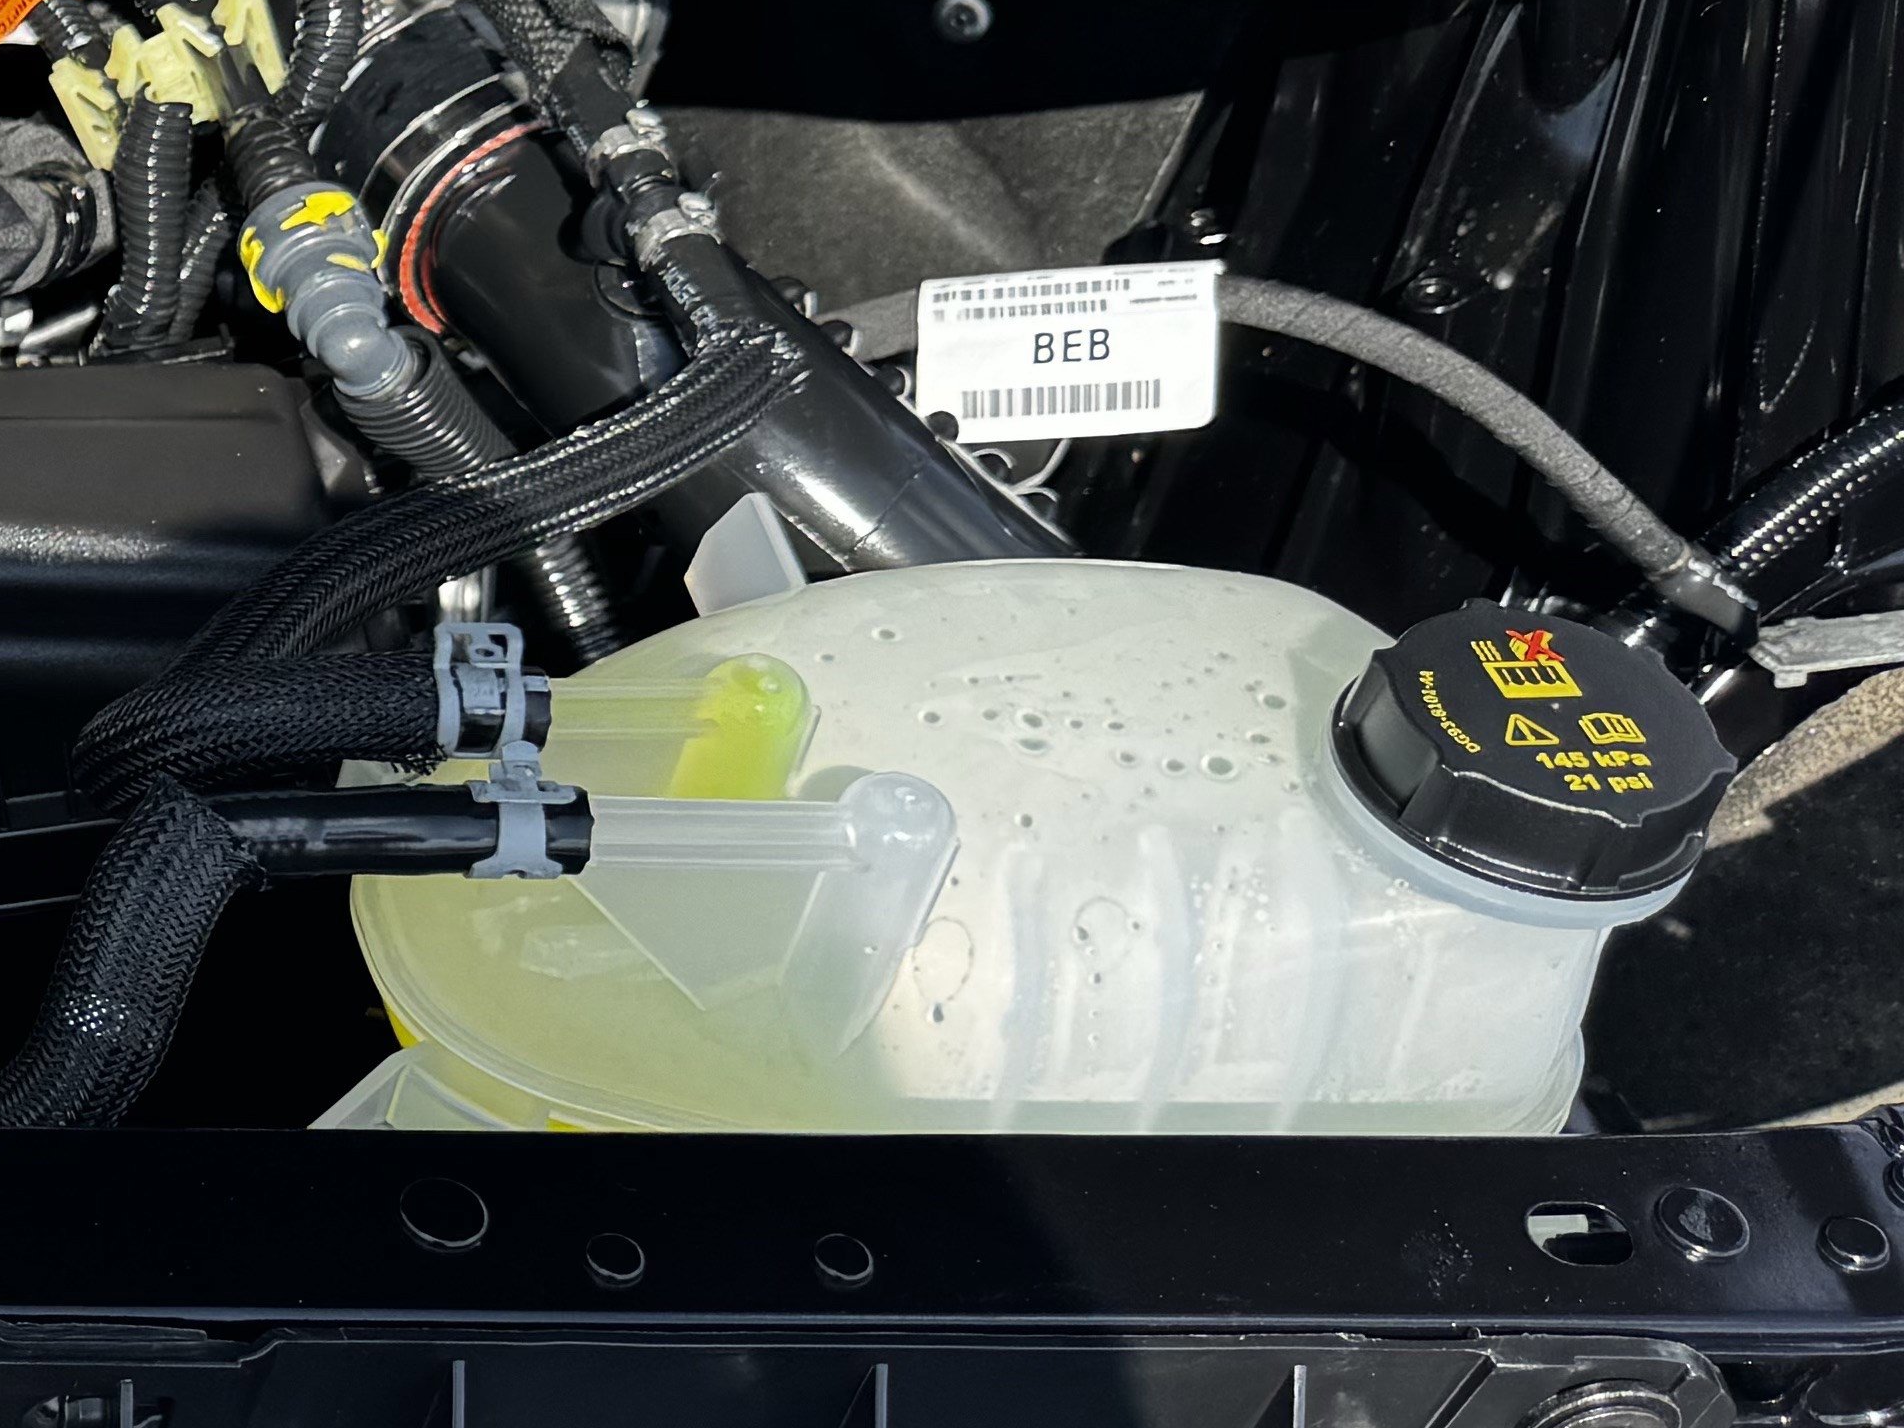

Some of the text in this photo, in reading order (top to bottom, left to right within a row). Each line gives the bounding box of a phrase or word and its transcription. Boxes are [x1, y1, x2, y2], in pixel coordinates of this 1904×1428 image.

[1033, 328, 1110, 364] BEB
[1535, 750, 1652, 769] 145 kPa
[1564, 772, 1654, 793] 21 psi
